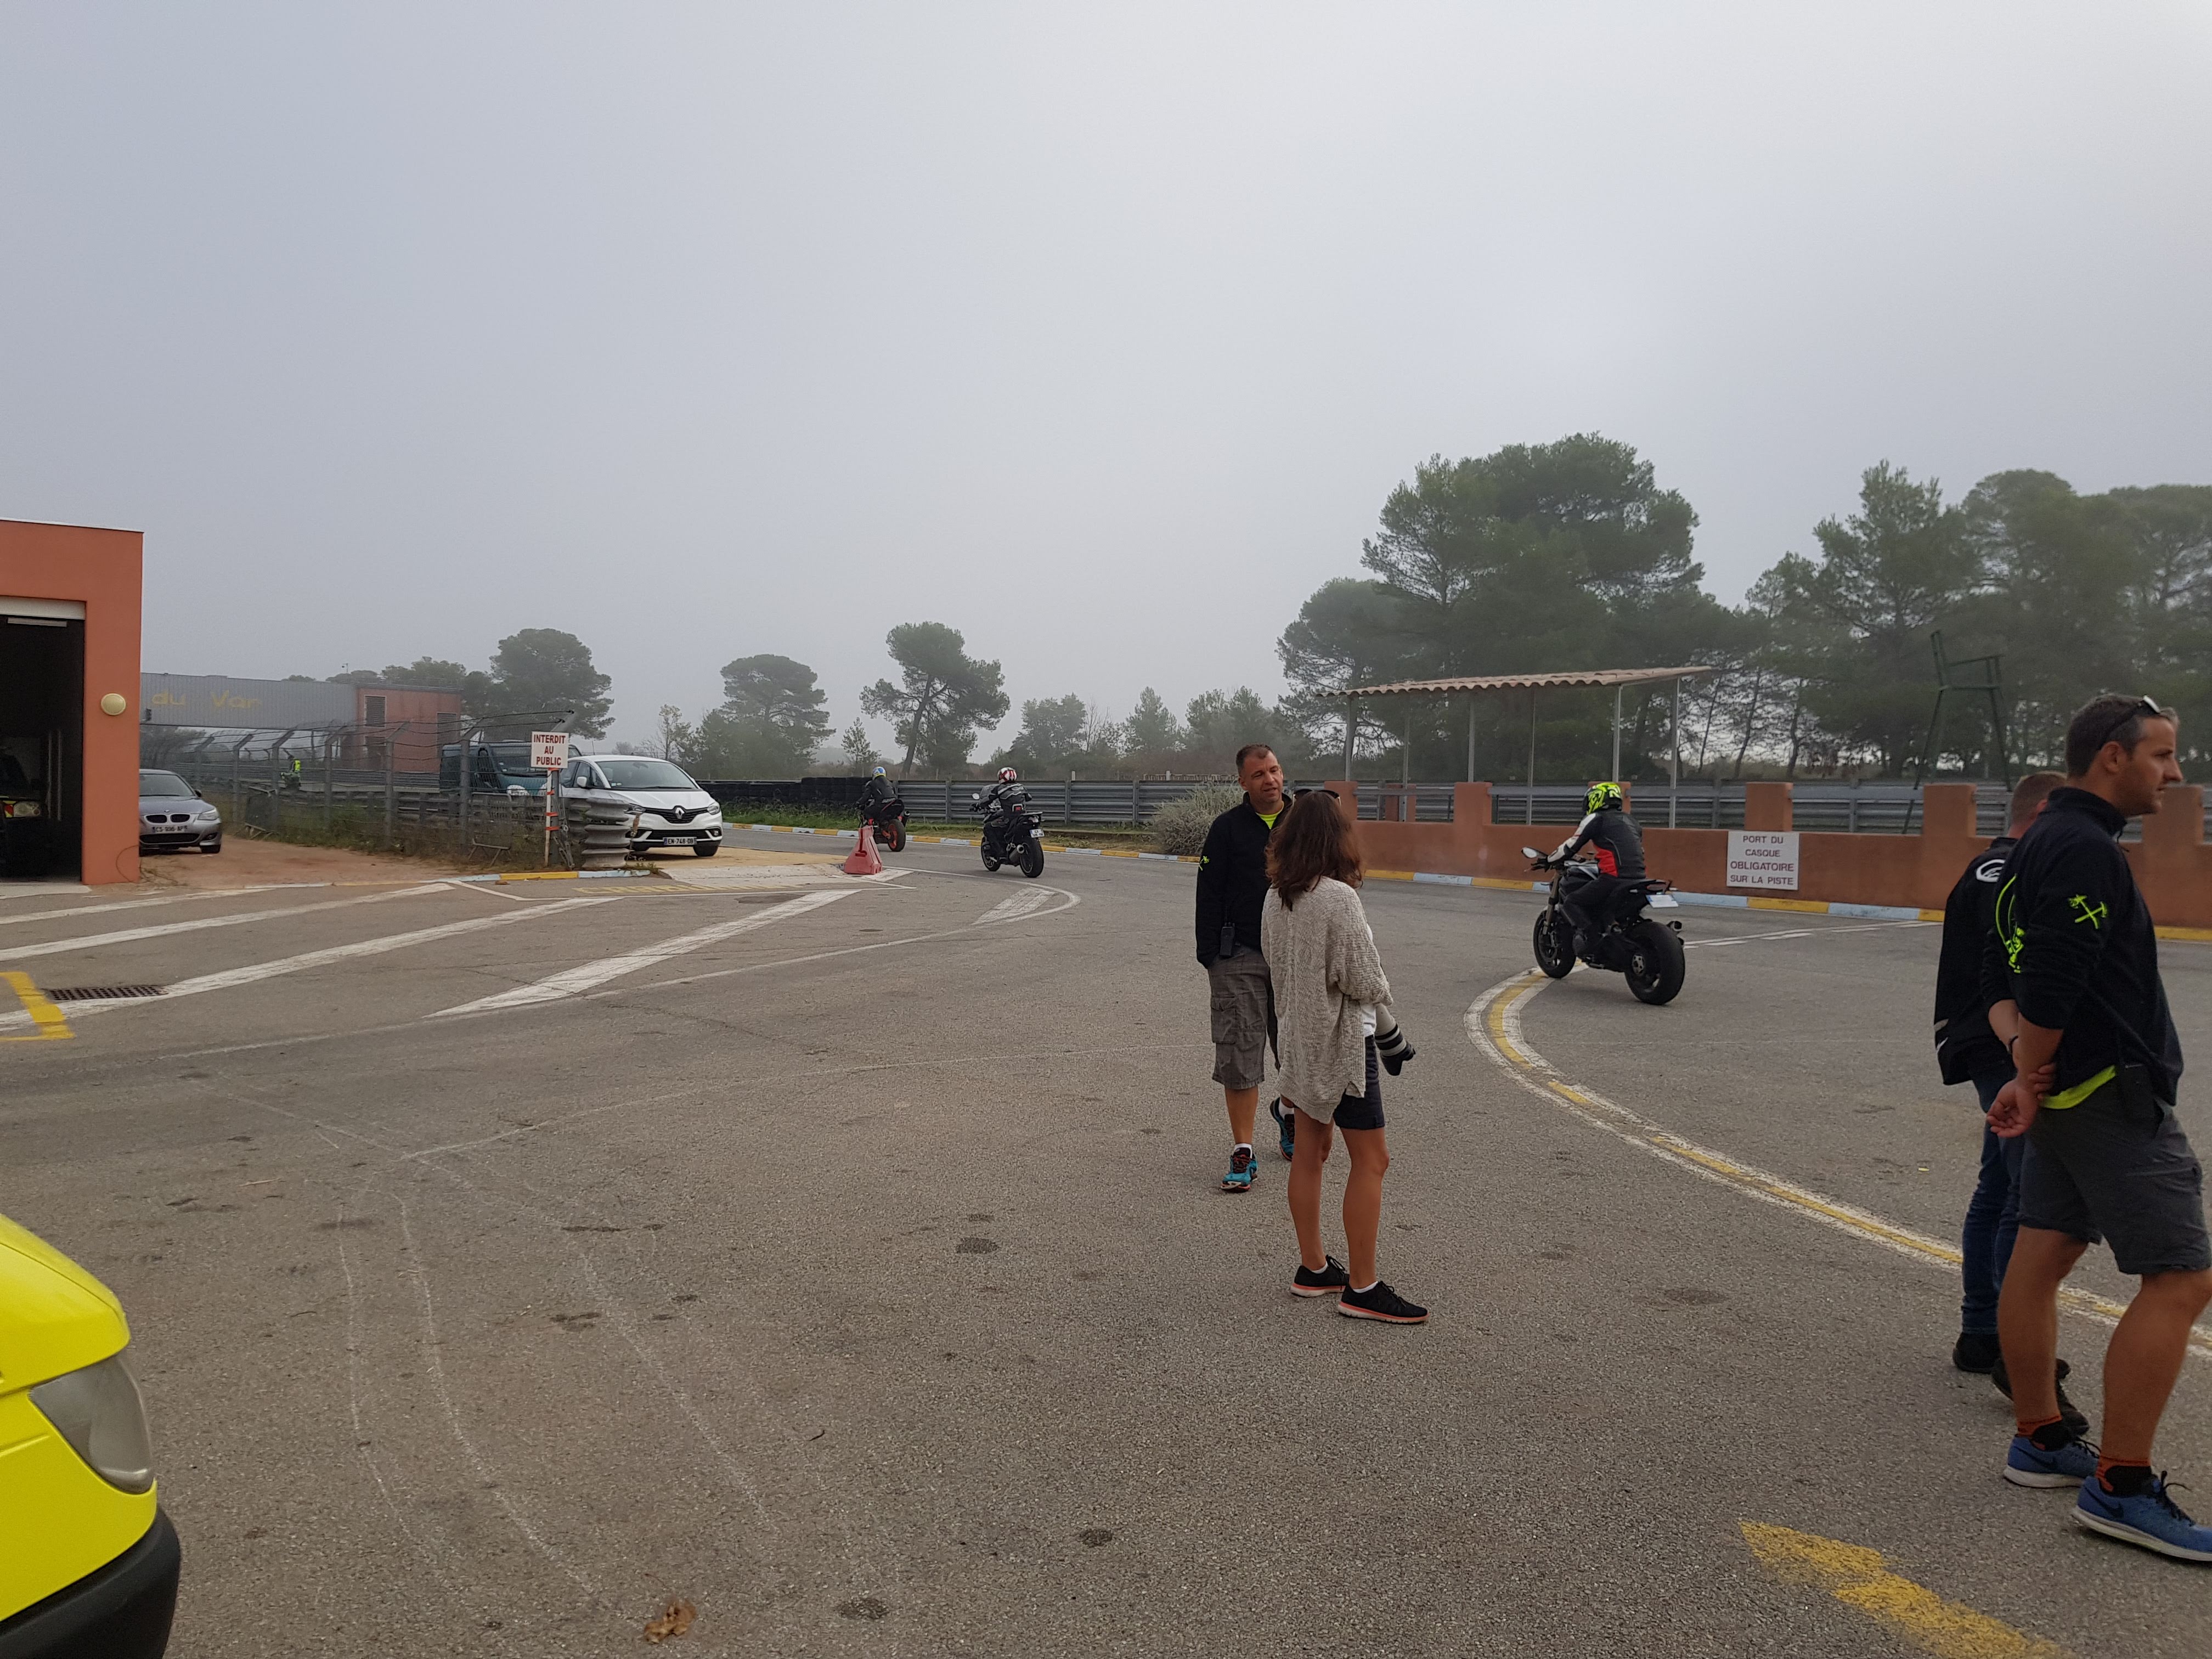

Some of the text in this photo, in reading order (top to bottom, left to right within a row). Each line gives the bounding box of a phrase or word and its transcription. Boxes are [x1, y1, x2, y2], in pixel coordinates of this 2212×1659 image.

[151, 688, 263, 708] du Var
[534, 734, 566, 744] INTERDIT
[544, 746, 554, 754] AU
[536, 757, 561, 766] PUBLIC
[1745, 849, 1781, 857] CASQUE
[1730, 861, 1795, 872] OBLIGATOIRE
[1730, 874, 1748, 883] SUR
[1768, 877, 1793, 885] PISTE
